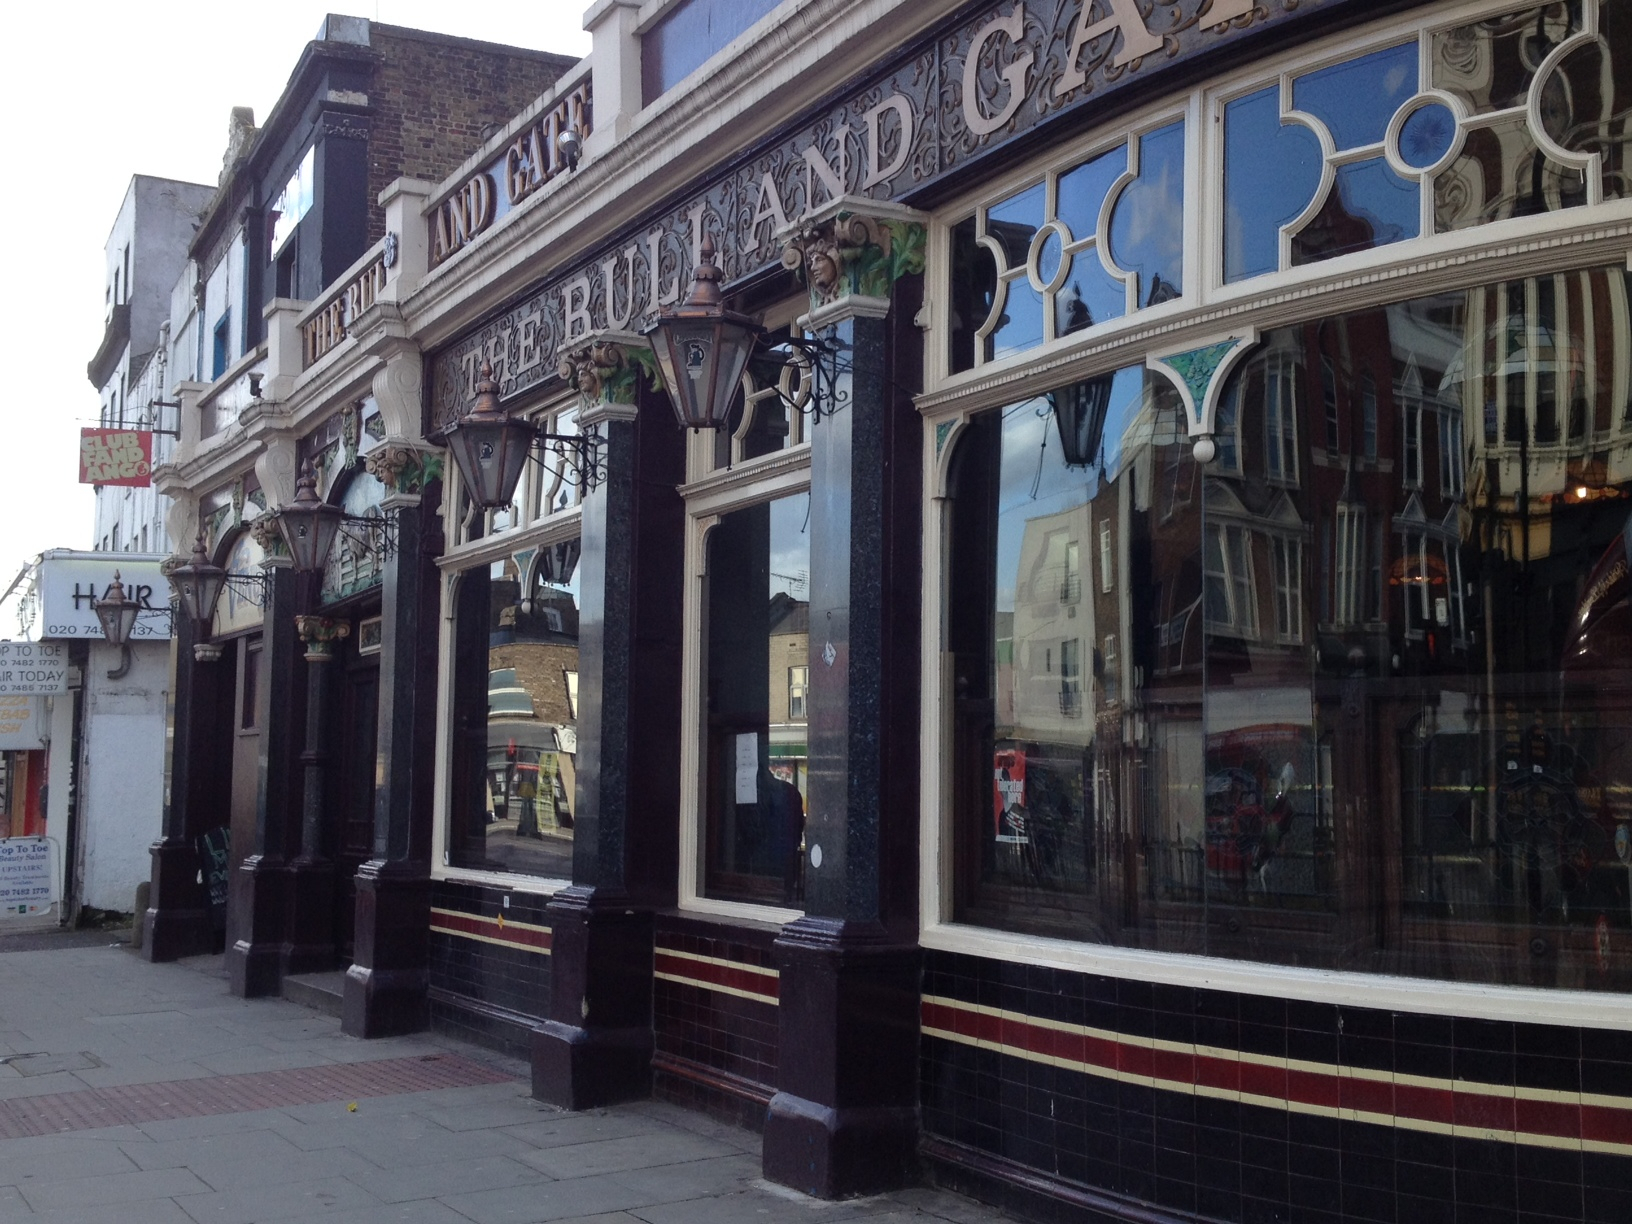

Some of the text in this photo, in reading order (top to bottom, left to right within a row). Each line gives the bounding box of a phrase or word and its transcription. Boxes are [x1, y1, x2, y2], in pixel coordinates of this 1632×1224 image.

[302, 295, 345, 364] THE
[433, 171, 497, 264] AND
[504, 82, 592, 206] GATE
[461, 307, 543, 400] THE
[560, 202, 725, 350] BULL
[741, 93, 915, 256] AND
[81, 432, 140, 452] CLUB
[82, 447, 145, 467] FAND
[49, 625, 77, 635] 020
[15, 645, 32, 657] TO
[38, 645, 62, 657] TOE
[11, 659, 35, 667] 7482
[38, 659, 60, 667] 1770
[18, 670, 65, 682] TODAY
[11, 684, 35, 692] 7485
[38, 684, 59, 692] 7137
[16, 845, 28, 853] To
[31, 844, 48, 852] Toe
[32, 887, 50, 895] 1770
